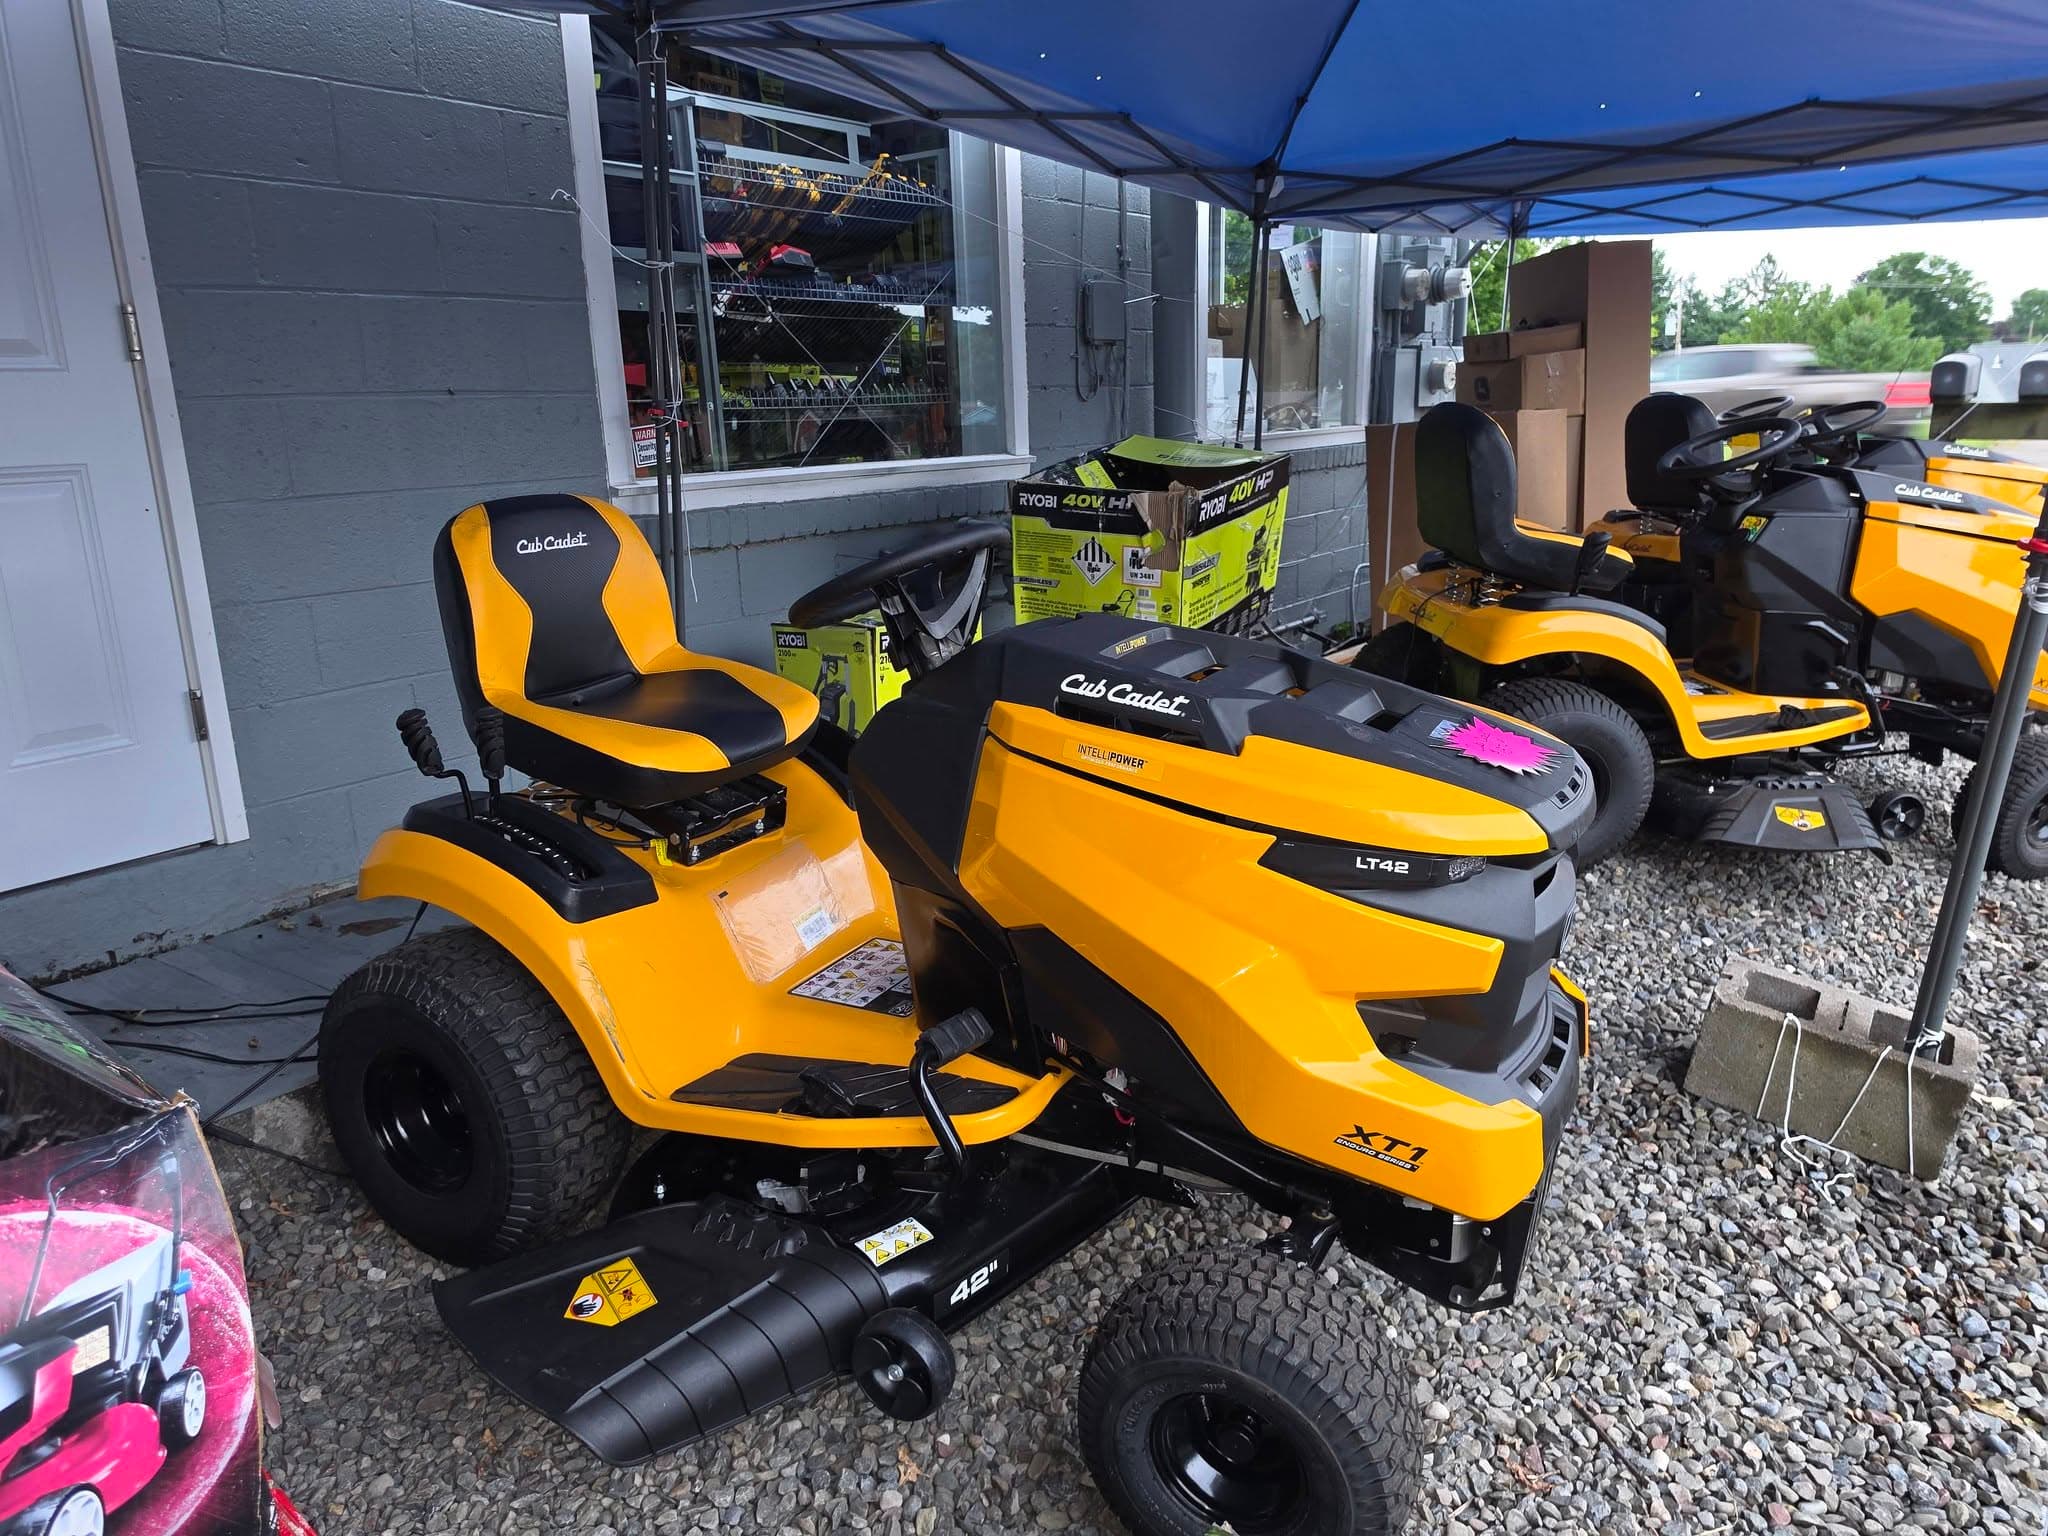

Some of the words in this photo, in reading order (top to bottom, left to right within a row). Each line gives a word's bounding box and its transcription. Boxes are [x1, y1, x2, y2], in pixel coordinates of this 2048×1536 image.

[1943, 444, 1961, 454] Cub
[1961, 446, 1989, 457] Cadet
[1019, 493, 1057, 508] RYOBI
[1062, 493, 1106, 508] 40V
[1199, 494, 1227, 522] RYOBI
[1229, 477, 1256, 503] 40V
[1255, 469, 1274, 492] HP
[1894, 484, 1920, 496] Cub
[1921, 488, 1962, 503] Cadet
[516, 536, 543, 554] Cub
[544, 531, 588, 550] Cadet
[777, 633, 806, 647] RYOBI
[1115, 635, 1147, 655] INTELLIPOWER
[778, 648, 792, 657] 2100
[1060, 673, 1107, 698] Cub
[1107, 683, 1190, 716] Cadet
[1077, 743, 1145, 769] INTELLIPOWER
[1355, 856, 1409, 874] LT42
[1336, 1138, 1377, 1156] ENDURO
[1377, 1153, 1412, 1169] SERIES
[1341, 1124, 1429, 1162] XT1
[950, 1258, 998, 1306] 42"
